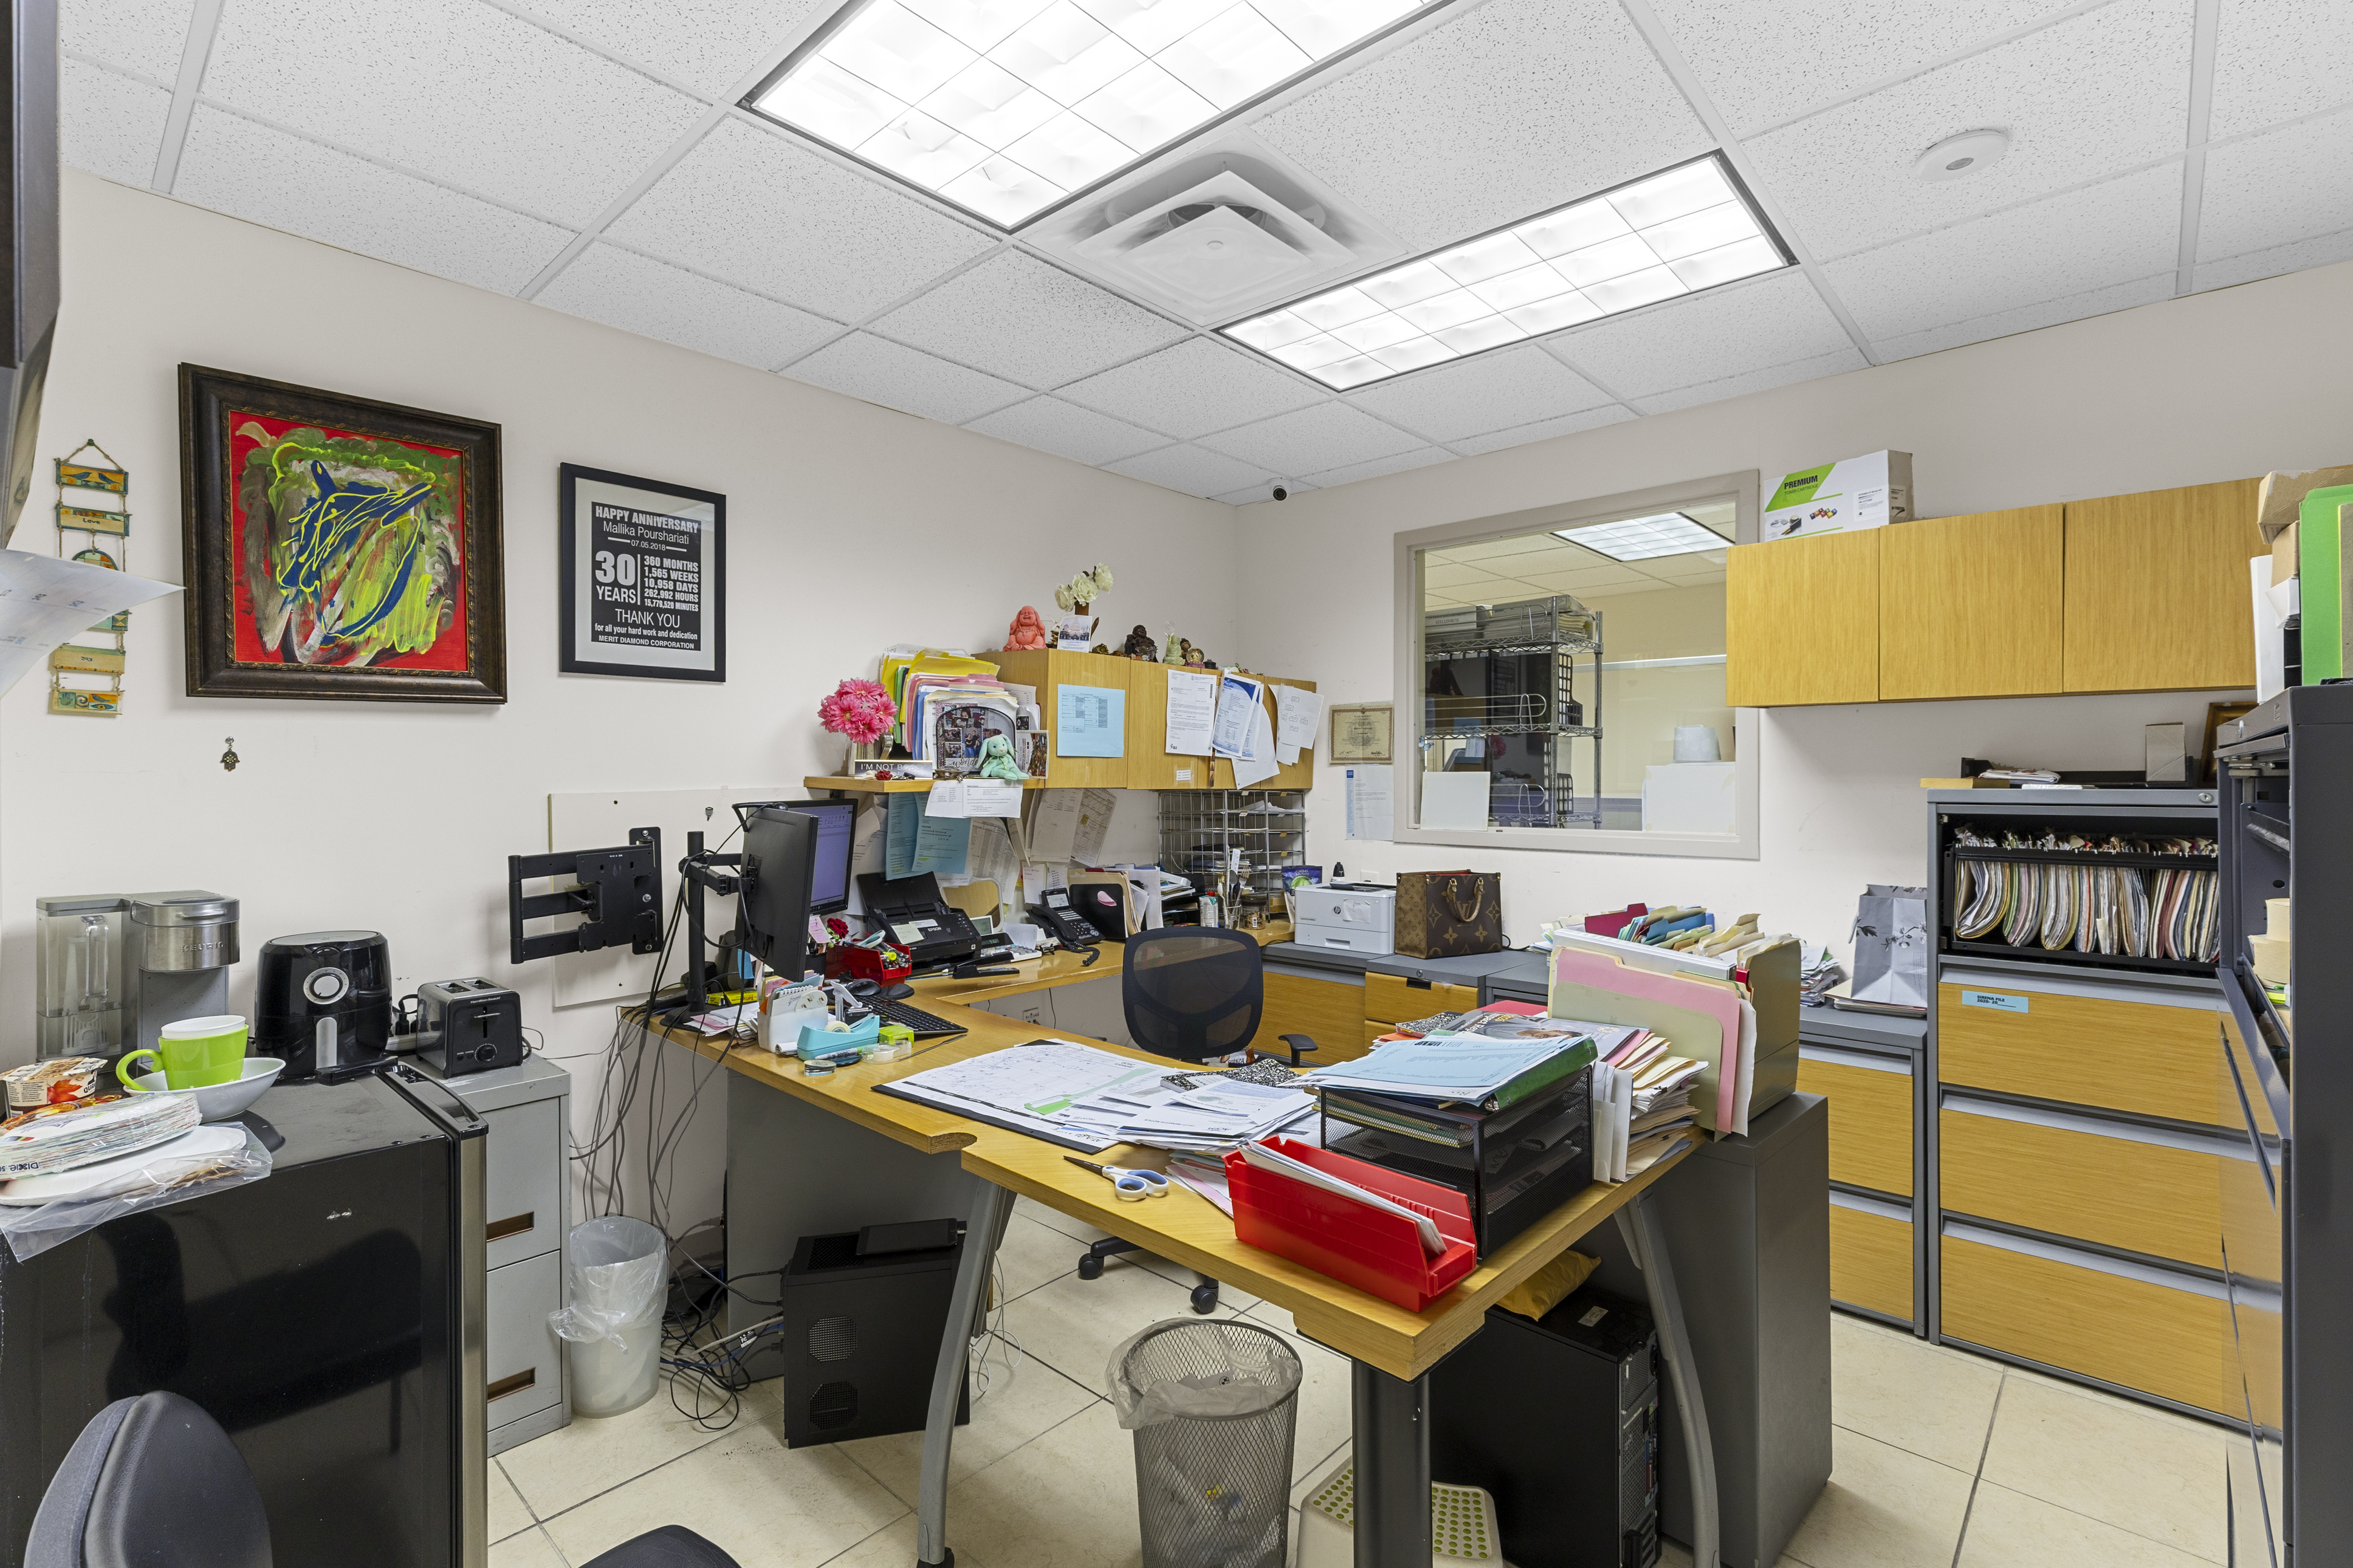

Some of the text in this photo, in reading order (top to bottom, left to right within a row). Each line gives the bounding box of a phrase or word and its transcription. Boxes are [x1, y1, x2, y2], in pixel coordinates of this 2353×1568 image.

[1784, 475, 1818, 489] PREMIUM
[1797, 484, 1818, 492] CARTRIDGE
[596, 505, 698, 533] HAPPY ANNIVERSARY
[603, 521, 689, 544] Mallika Pourshariati
[631, 540, 665, 550] 07.05.2018
[596, 550, 636, 586] 30
[644, 555, 698, 572] 360 MONTHS
[644, 567, 698, 583] 1,565 WEEKS
[644, 578, 698, 593] 10,958 DAYS
[596, 585, 636, 603] YEARS
[644, 589, 698, 603] 262,992 HOURS
[645, 599, 698, 612] 15,779,520 MINUTES
[615, 609, 680, 628] THANK YOU
[628, 626, 641, 635] hard
[670, 631, 698, 640] dedication
[650, 640, 694, 649] CORPORATION
